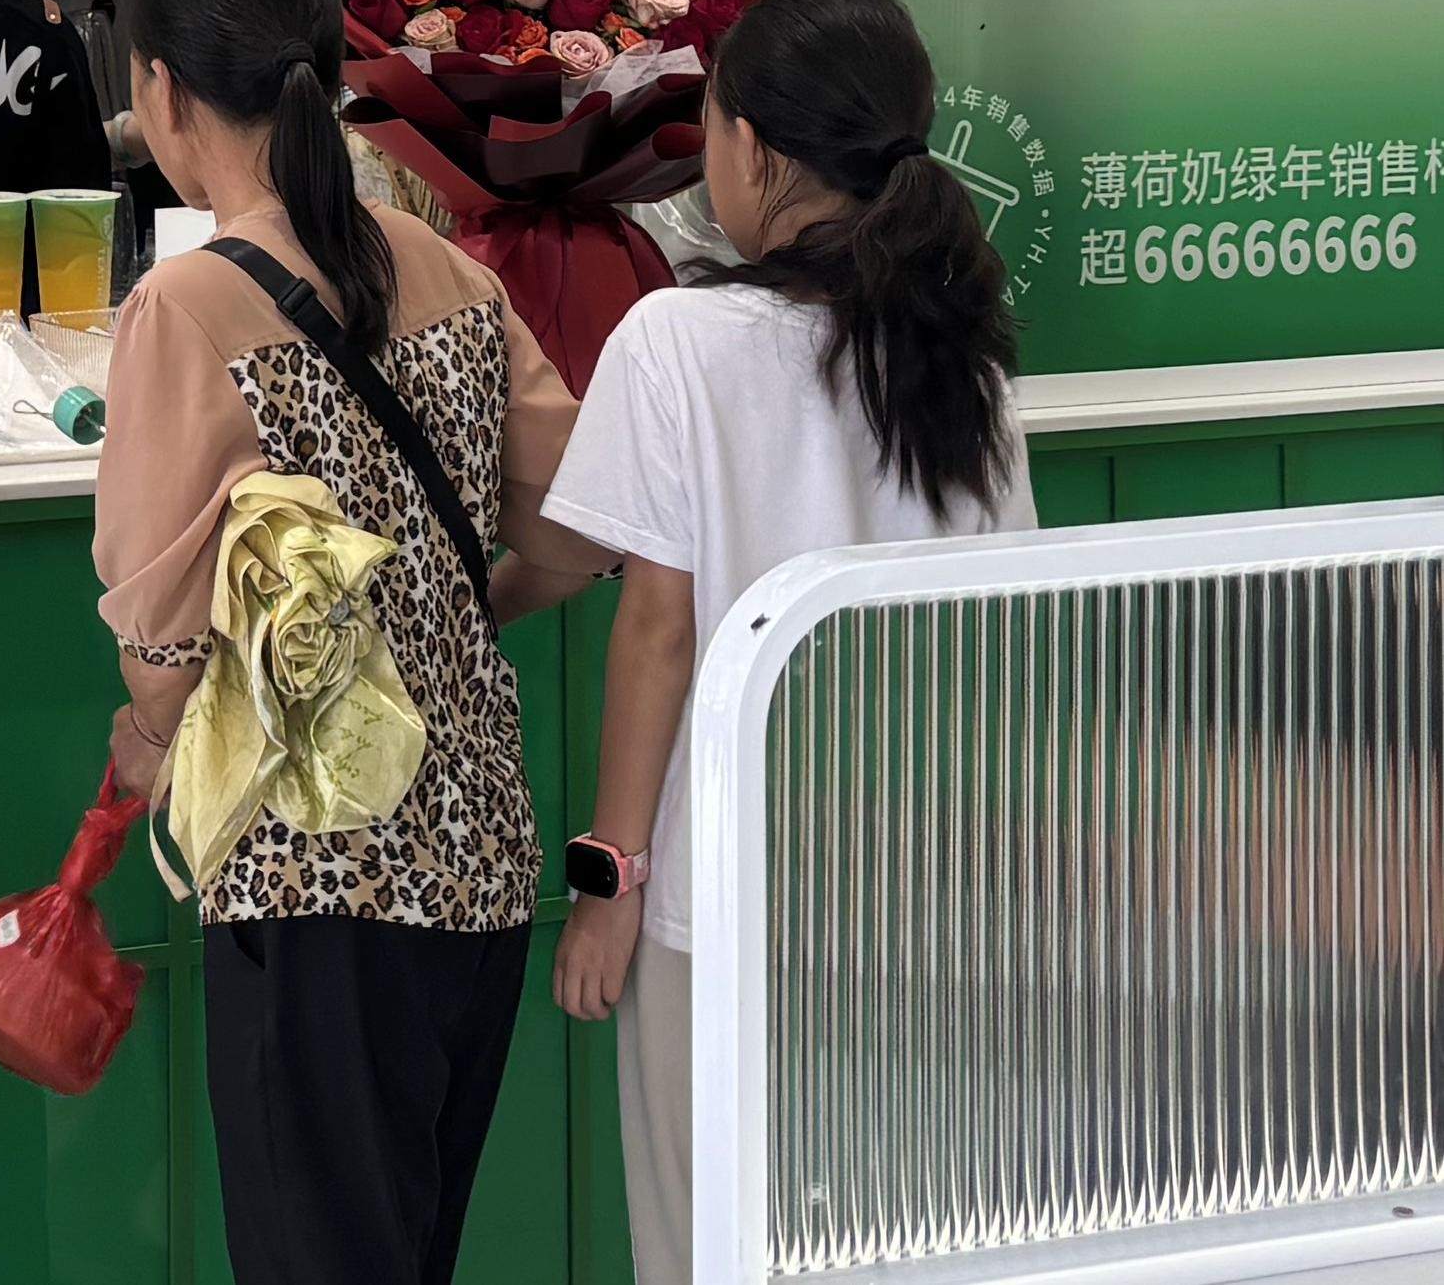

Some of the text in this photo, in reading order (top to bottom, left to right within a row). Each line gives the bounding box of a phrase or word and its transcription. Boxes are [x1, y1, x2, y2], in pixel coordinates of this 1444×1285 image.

[932, 84, 1055, 197] 4年销售数据
